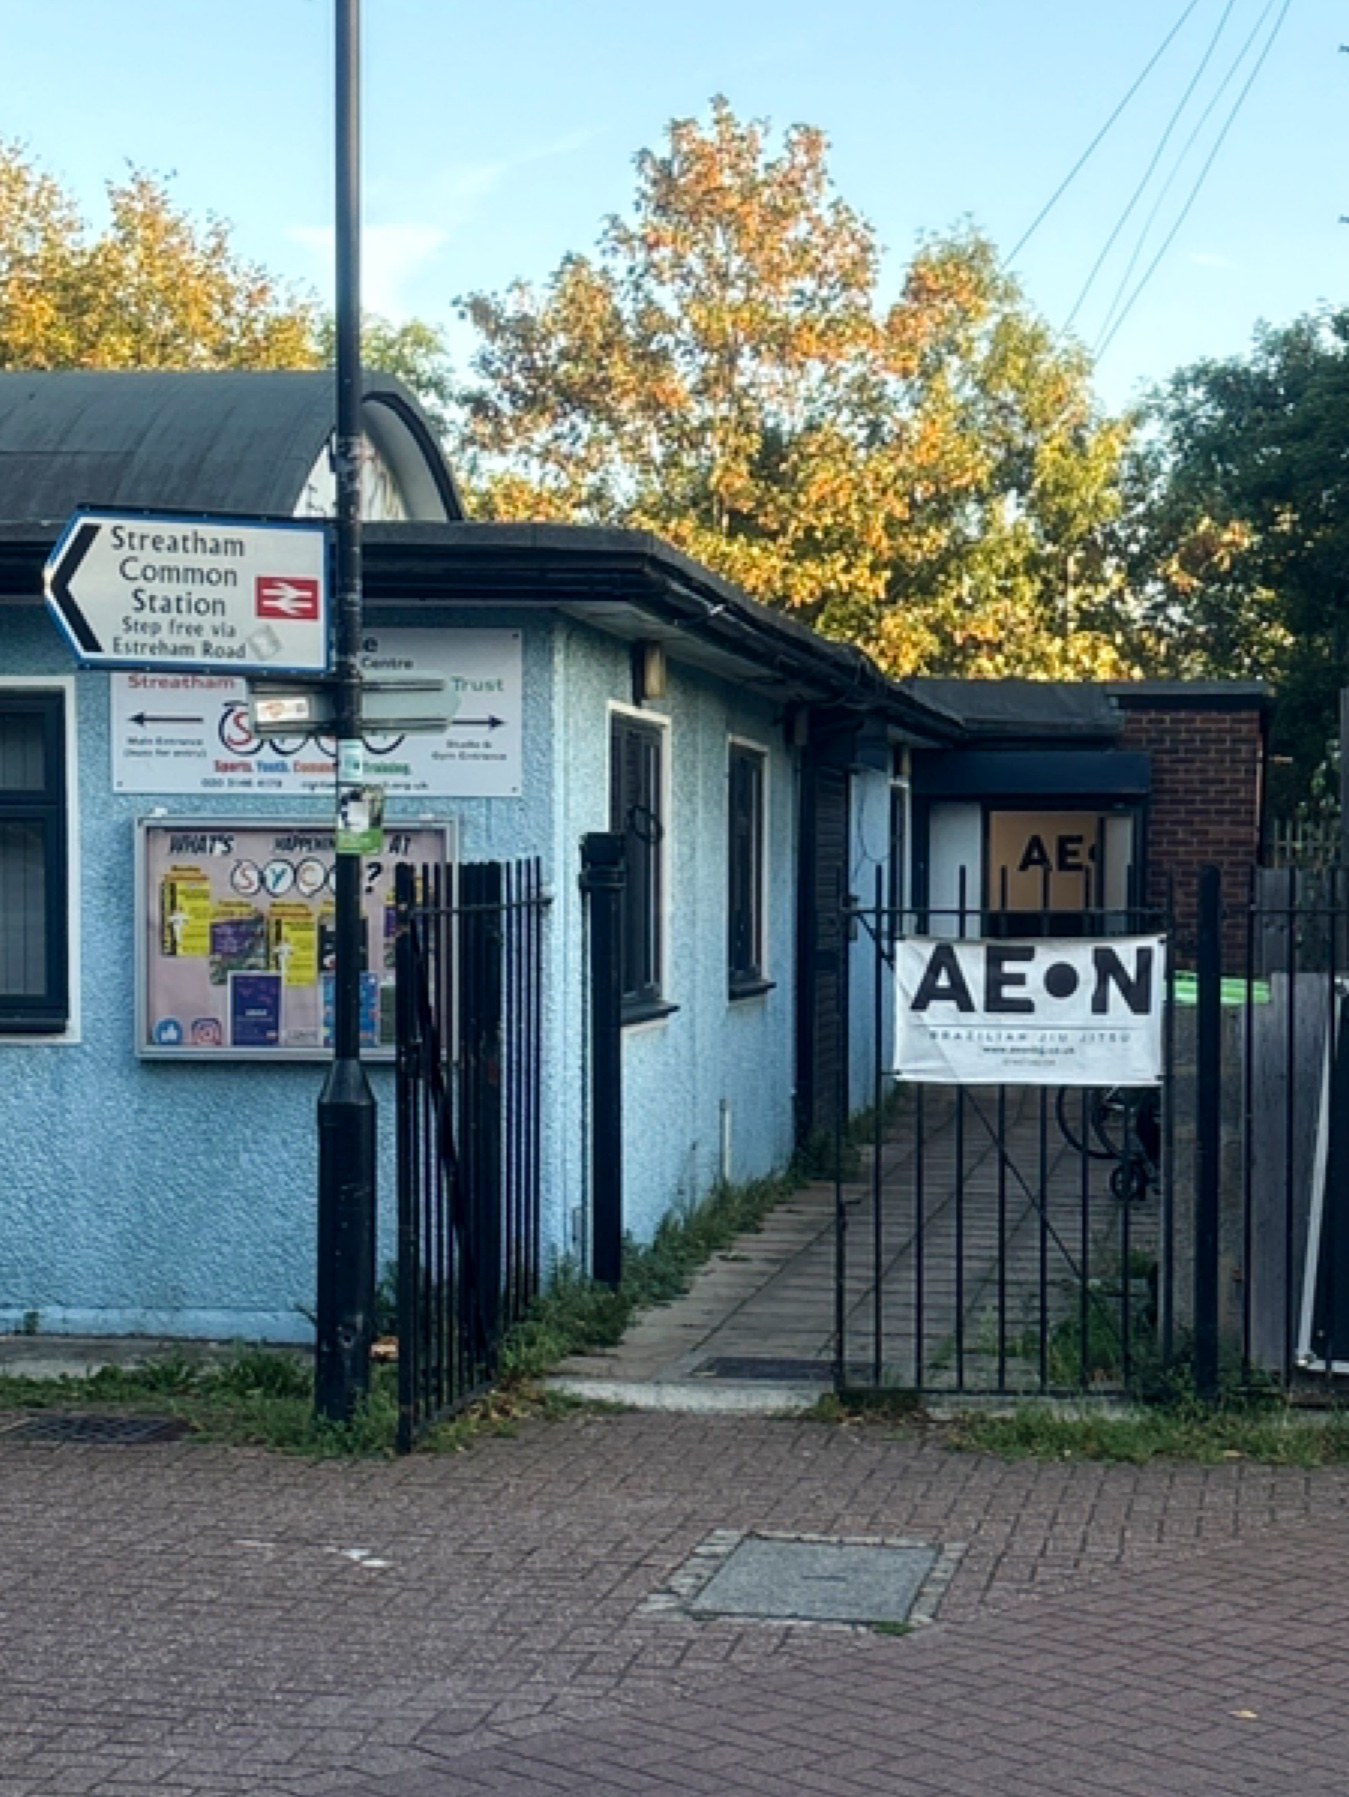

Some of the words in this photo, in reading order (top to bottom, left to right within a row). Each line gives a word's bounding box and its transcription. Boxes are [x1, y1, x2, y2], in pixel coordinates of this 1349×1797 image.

[110, 525, 245, 557] Streatham
[119, 556, 238, 587] Common
[131, 588, 226, 617] Station
[122, 616, 161, 637] Step
[168, 617, 204, 637] free
[211, 619, 236, 638] via
[112, 637, 195, 658] Estreham
[202, 640, 247, 660] Road
[362, 655, 414, 669] Centre
[128, 673, 235, 690] Streatham
[451, 675, 504, 692] Trust
